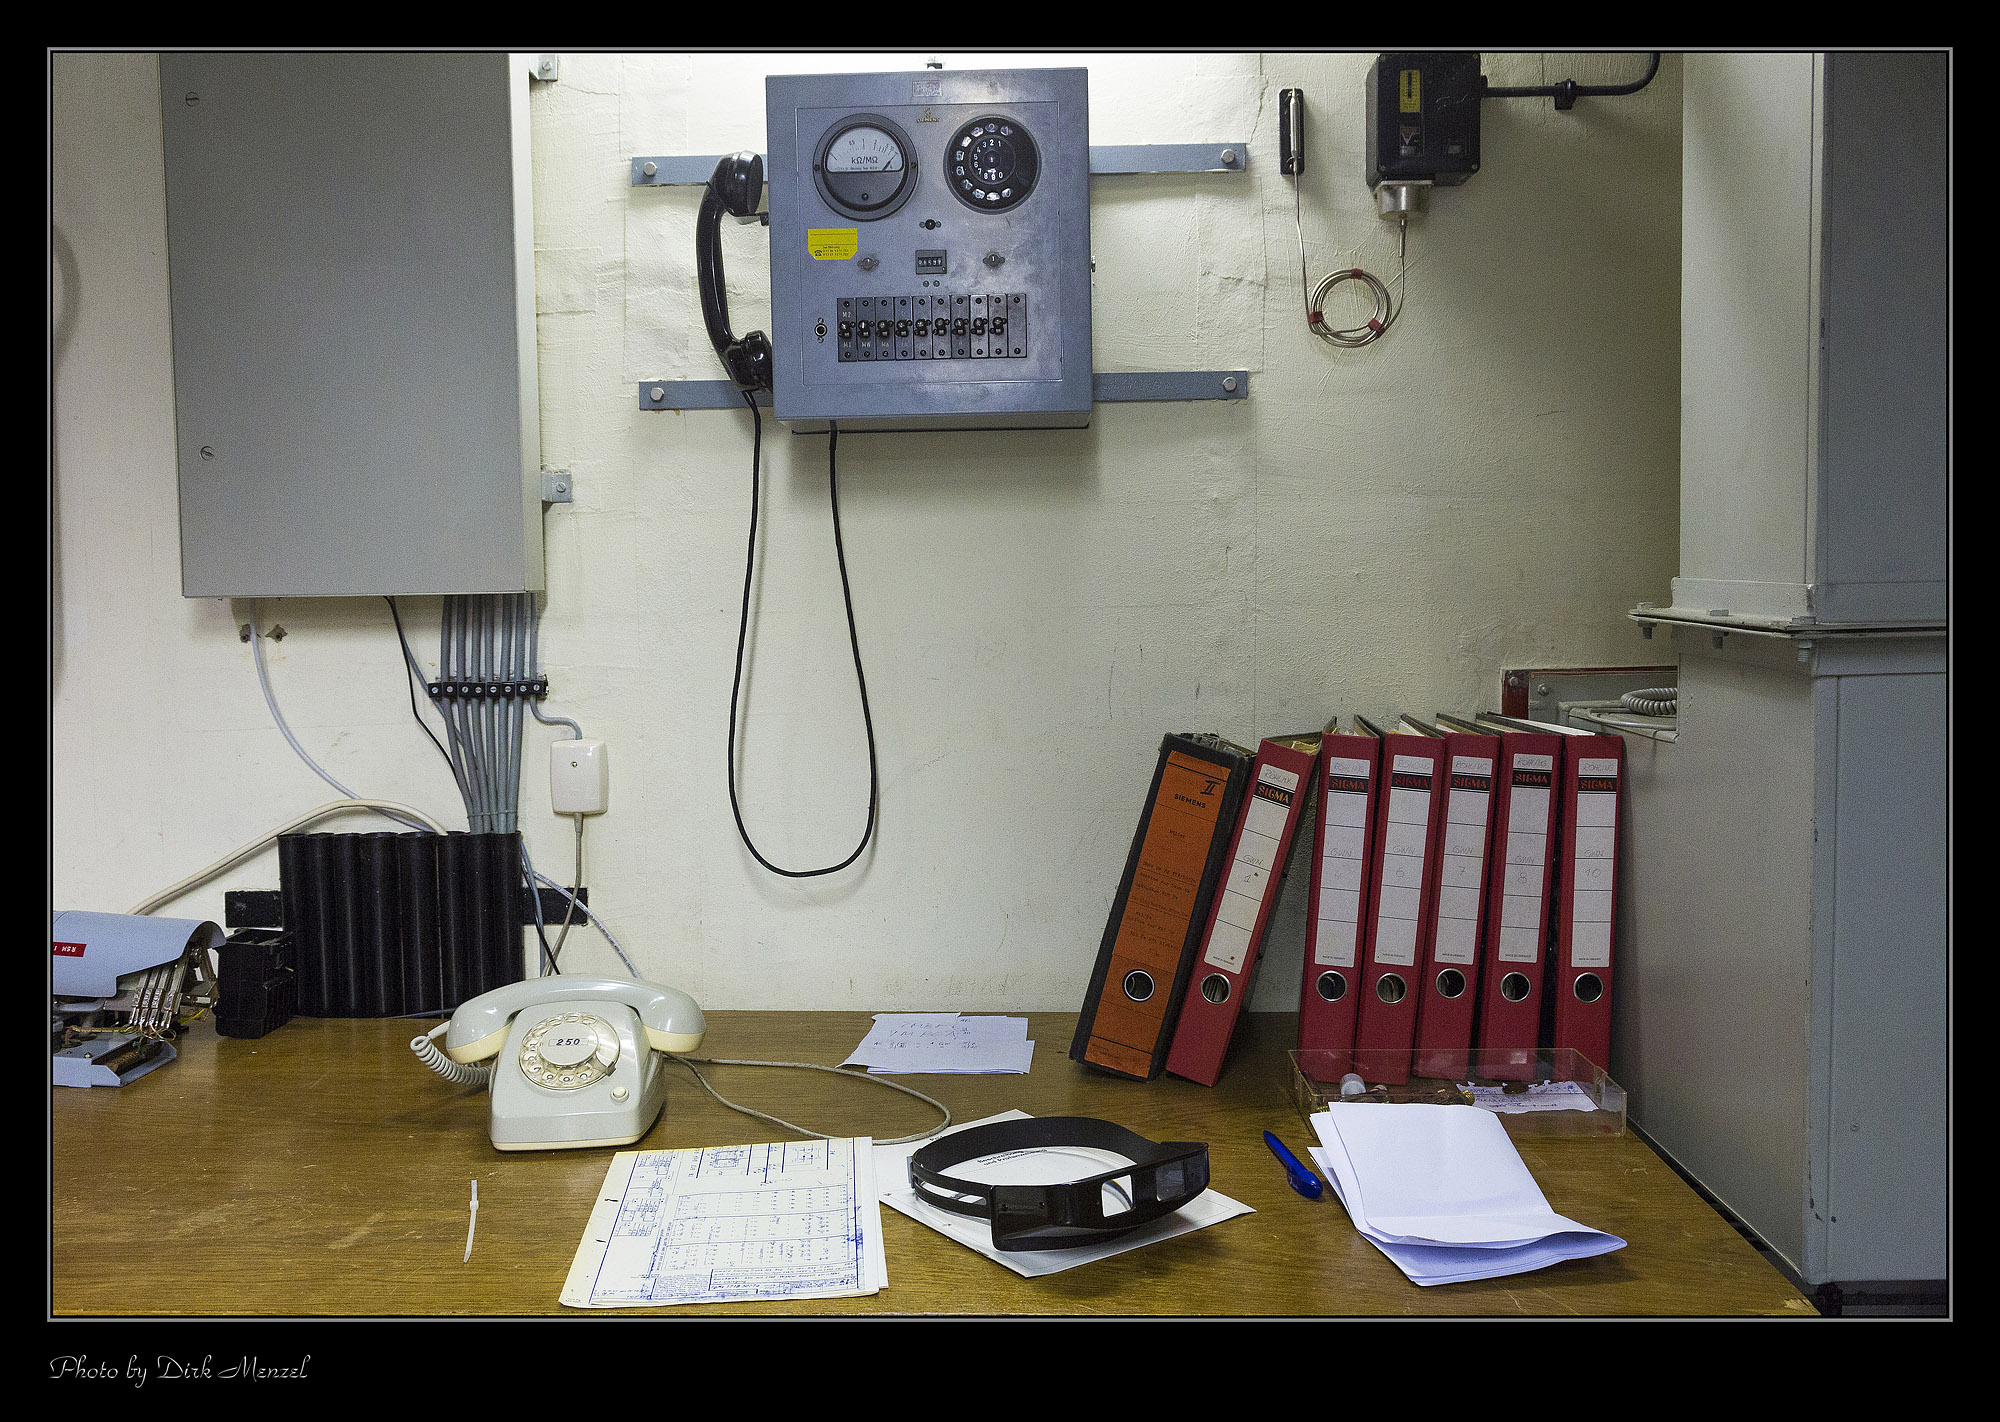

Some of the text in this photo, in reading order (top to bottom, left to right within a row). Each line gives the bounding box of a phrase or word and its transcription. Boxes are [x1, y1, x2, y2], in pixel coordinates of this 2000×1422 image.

[1331, 778, 1365, 791] SIGMA
[1394, 776, 1428, 789] SIGMA
[1453, 776, 1487, 789] SIGMA
[1515, 774, 1548, 784] SIGMA
[1580, 780, 1614, 790] SIGMA
[1174, 793, 1207, 809] SIEMENS
[1258, 785, 1289, 804] SIGMA
[556, 1038, 581, 1046] 250
